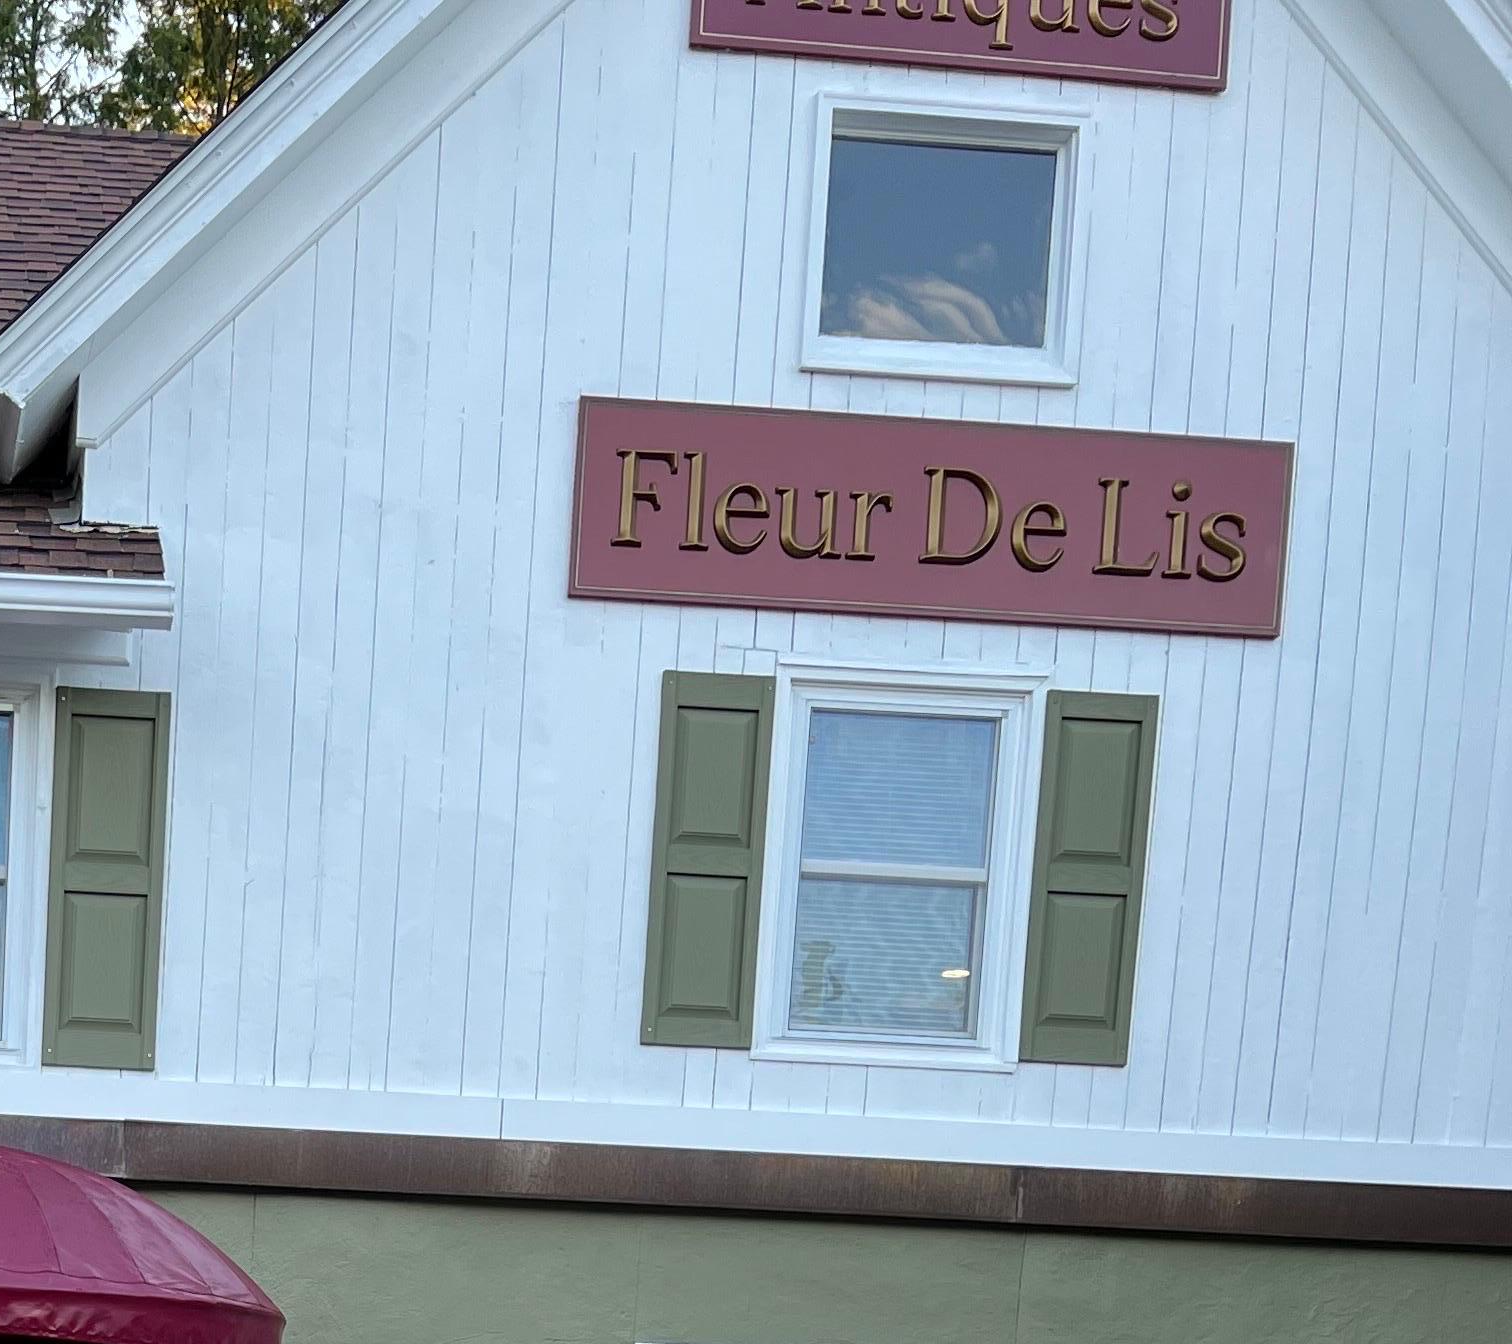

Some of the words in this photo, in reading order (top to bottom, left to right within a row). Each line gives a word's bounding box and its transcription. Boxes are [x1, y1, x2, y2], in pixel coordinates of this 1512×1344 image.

[610, 447, 894, 562] Fleur
[918, 465, 1068, 574] De
[1091, 475, 1248, 583] Lis
